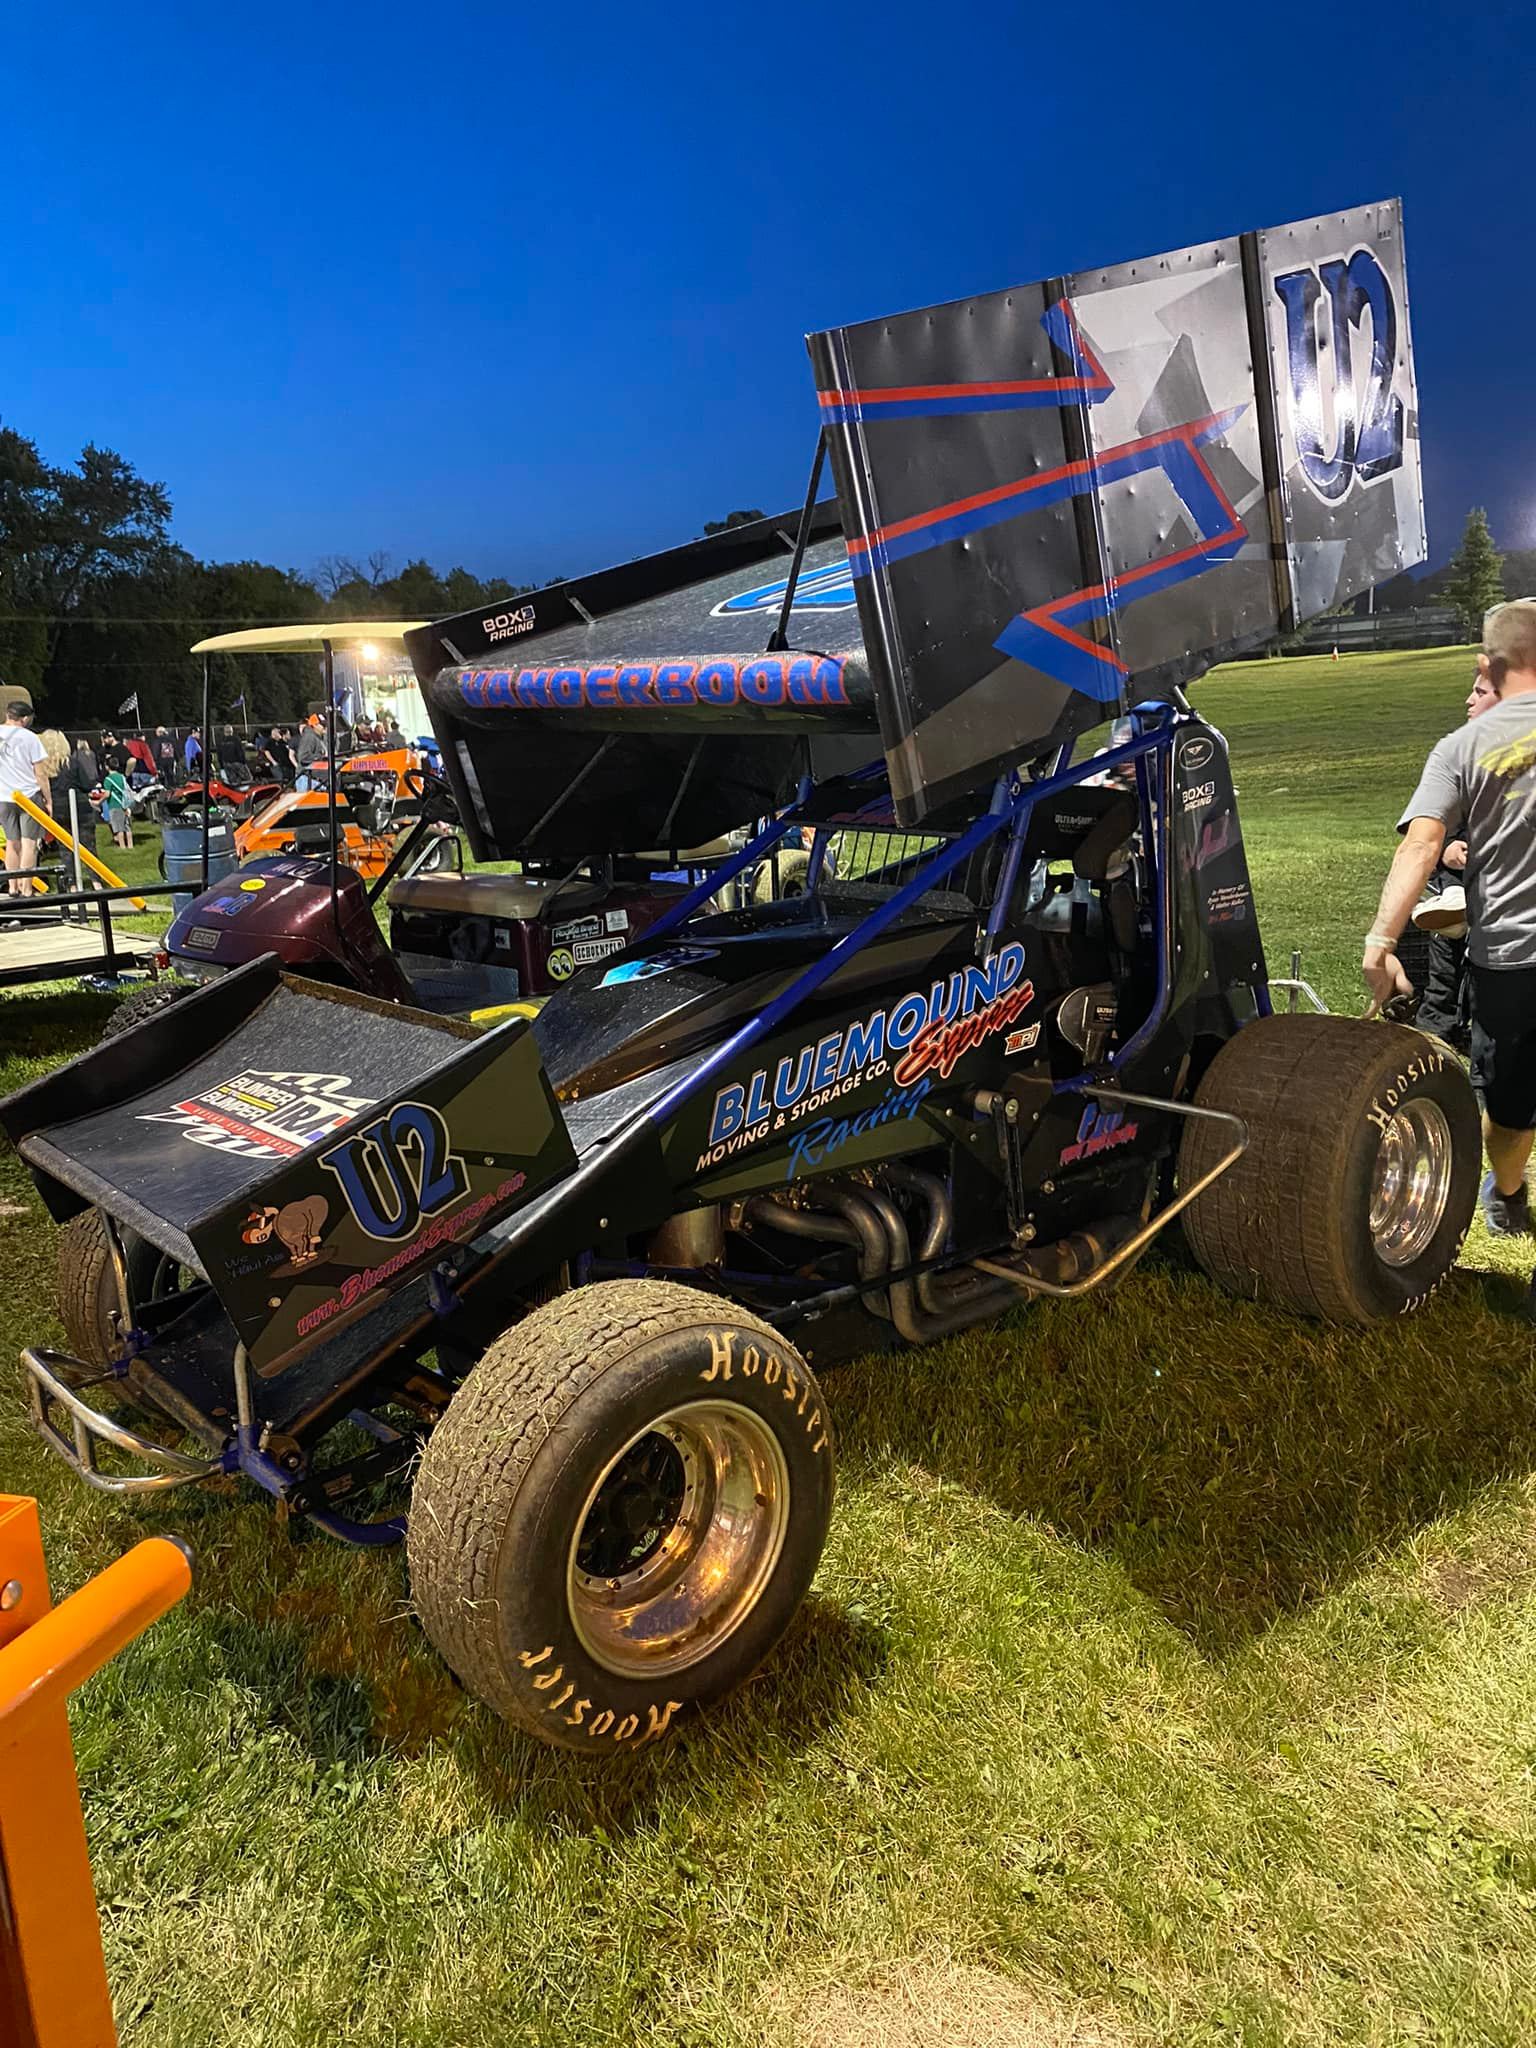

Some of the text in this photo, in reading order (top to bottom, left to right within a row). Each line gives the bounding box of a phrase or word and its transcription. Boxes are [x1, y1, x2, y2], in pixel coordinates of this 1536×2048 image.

[1270, 243, 1403, 507] U2
[457, 654, 851, 706] VANDERBOOM
[489, 620, 534, 642] RACING
[1184, 796, 1212, 812] RACING
[709, 941, 1026, 1146] BLUEMOUND
[894, 978, 1035, 1087] Express
[200, 1091, 267, 1121] BUMPER
[229, 1076, 297, 1105] BUMPER
[695, 1060, 891, 1172] MOVING & STORAGE CO.
[786, 1077, 935, 1181] Racing
[1366, 1052, 1444, 1138] Hoosier
[317, 1101, 472, 1242] U2
[296, 1172, 527, 1336] www.BluemoundExpress.com
[699, 1329, 830, 1453] Hoosier
[517, 1646, 684, 1750] Hoosier
